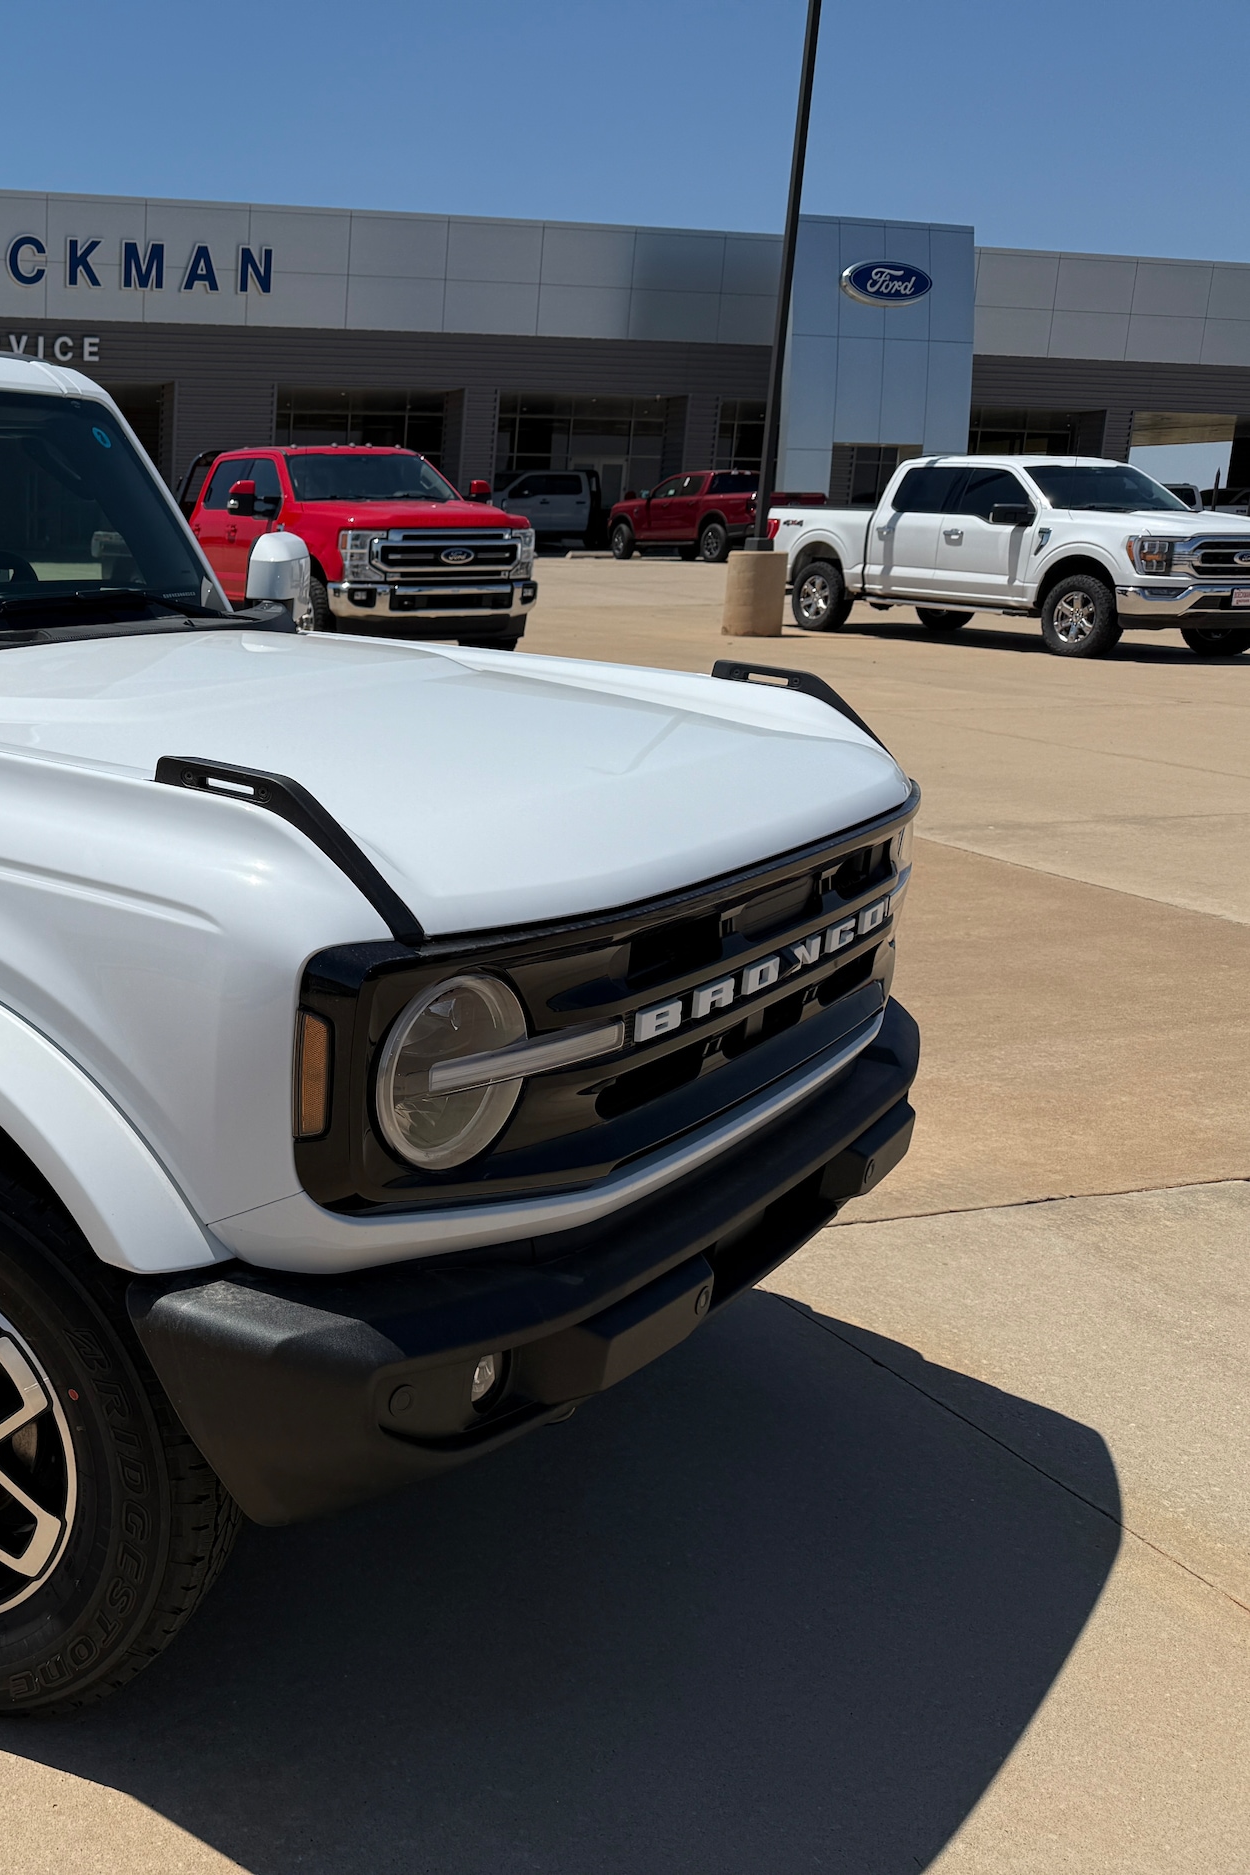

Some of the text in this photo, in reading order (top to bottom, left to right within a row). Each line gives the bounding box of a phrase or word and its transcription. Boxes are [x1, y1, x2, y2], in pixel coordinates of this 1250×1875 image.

[866, 268, 916, 295] Ford
[634, 899, 887, 1043] BRONCO
[9, 1326, 154, 1700] BRIDGESTONE
